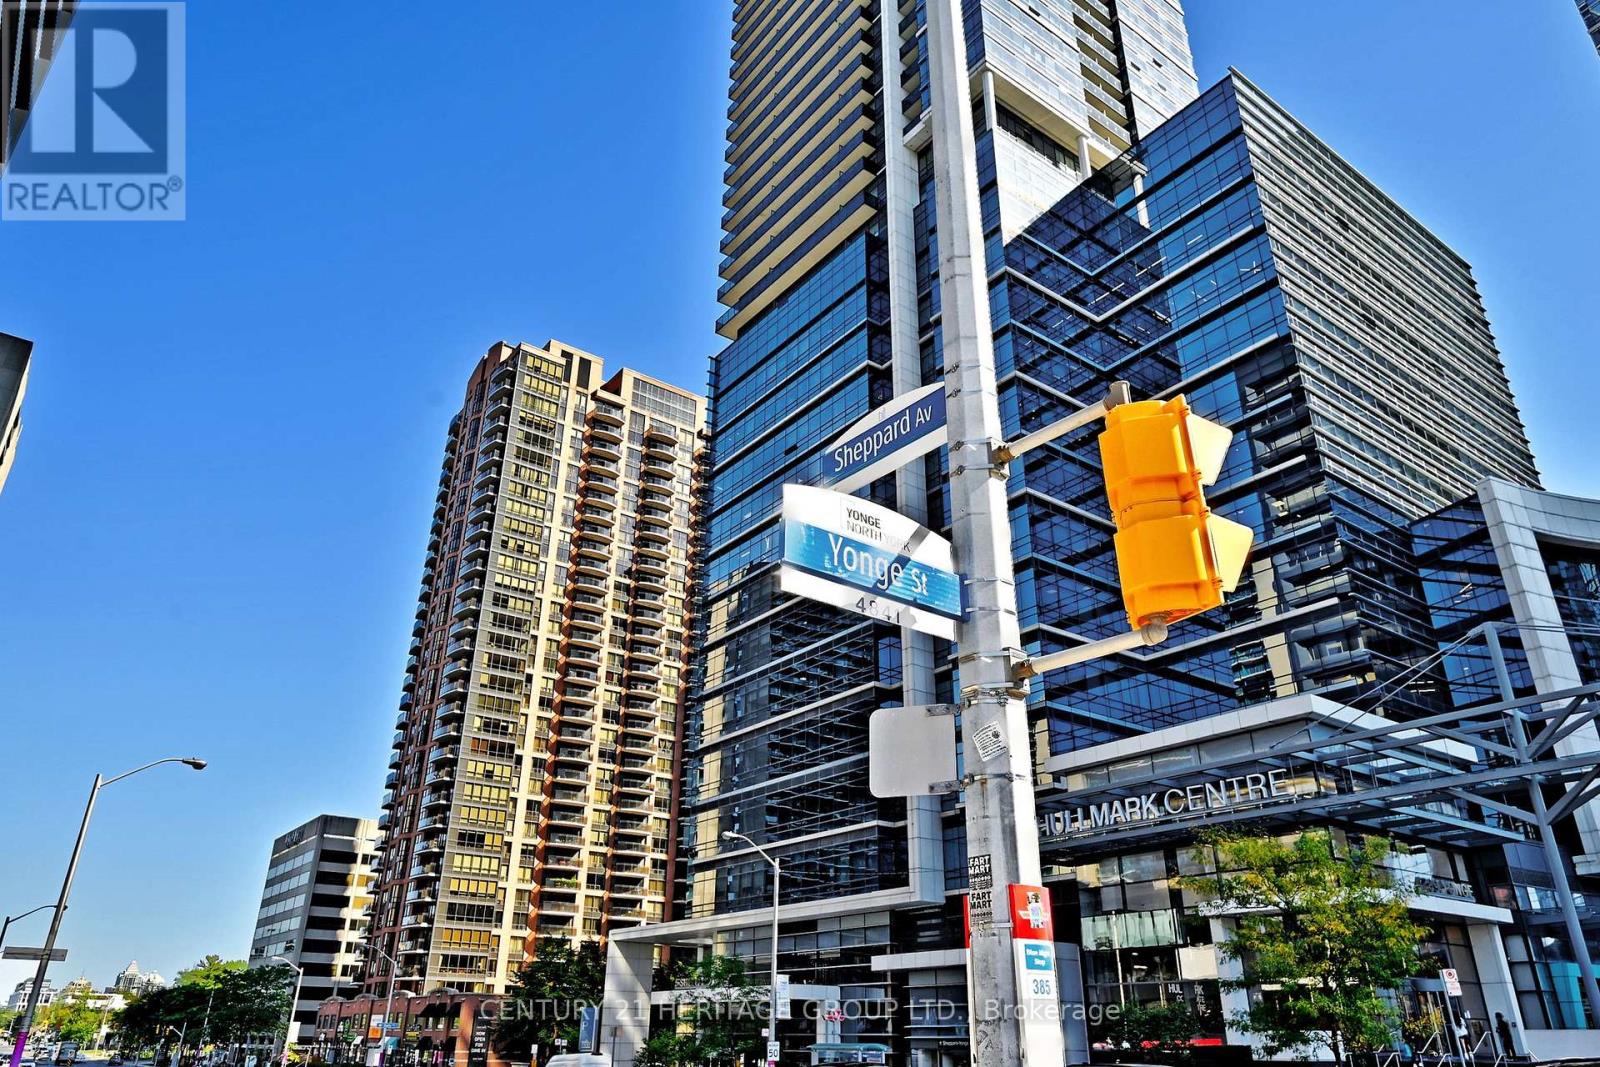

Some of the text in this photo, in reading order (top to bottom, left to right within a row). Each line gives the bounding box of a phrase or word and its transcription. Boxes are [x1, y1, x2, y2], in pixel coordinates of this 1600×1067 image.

[834, 405, 932, 472] Sheppard Av
[846, 507, 881, 529] YONGE
[847, 520, 882, 542] NORTH
[828, 533, 928, 596] Yonge St
[855, 597, 900, 624] 4841
[1164, 768, 1290, 814] CENTRE
[969, 856, 990, 867] FART
[971, 891, 991, 901] FART
[1032, 979, 1052, 995] 385
[768, 1048, 779, 1058] 50
